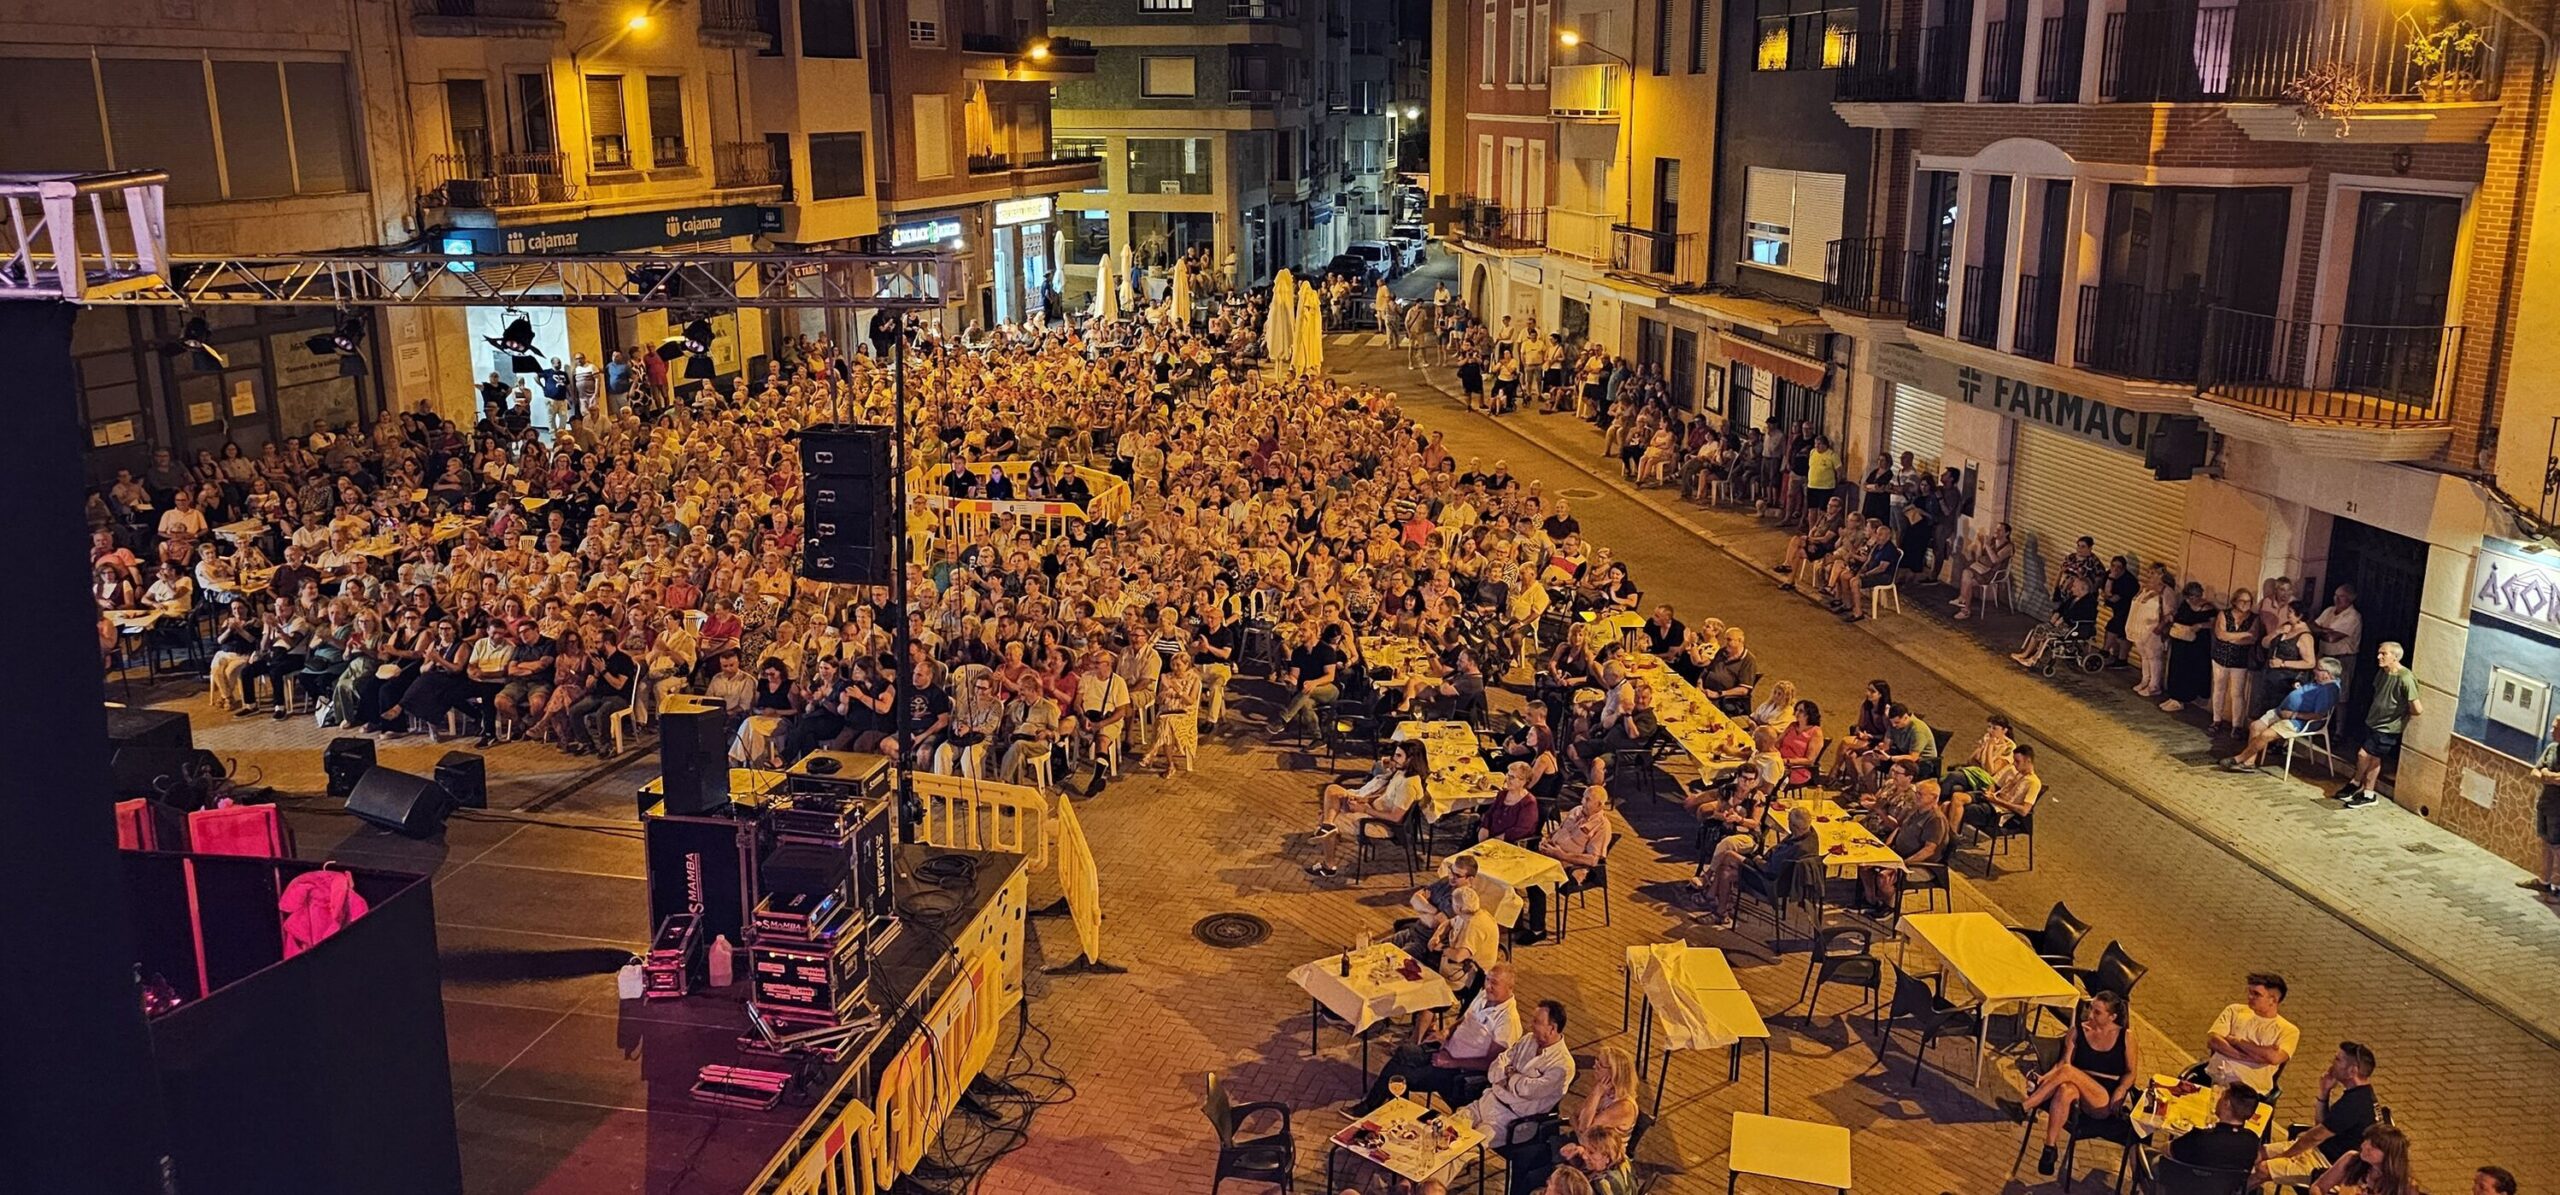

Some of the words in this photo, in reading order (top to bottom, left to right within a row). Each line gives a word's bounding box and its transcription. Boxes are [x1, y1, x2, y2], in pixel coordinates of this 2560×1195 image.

[682, 215, 723, 236] cajamar
[528, 231, 579, 254] cajamar
[2346, 501, 2358, 513] 21
